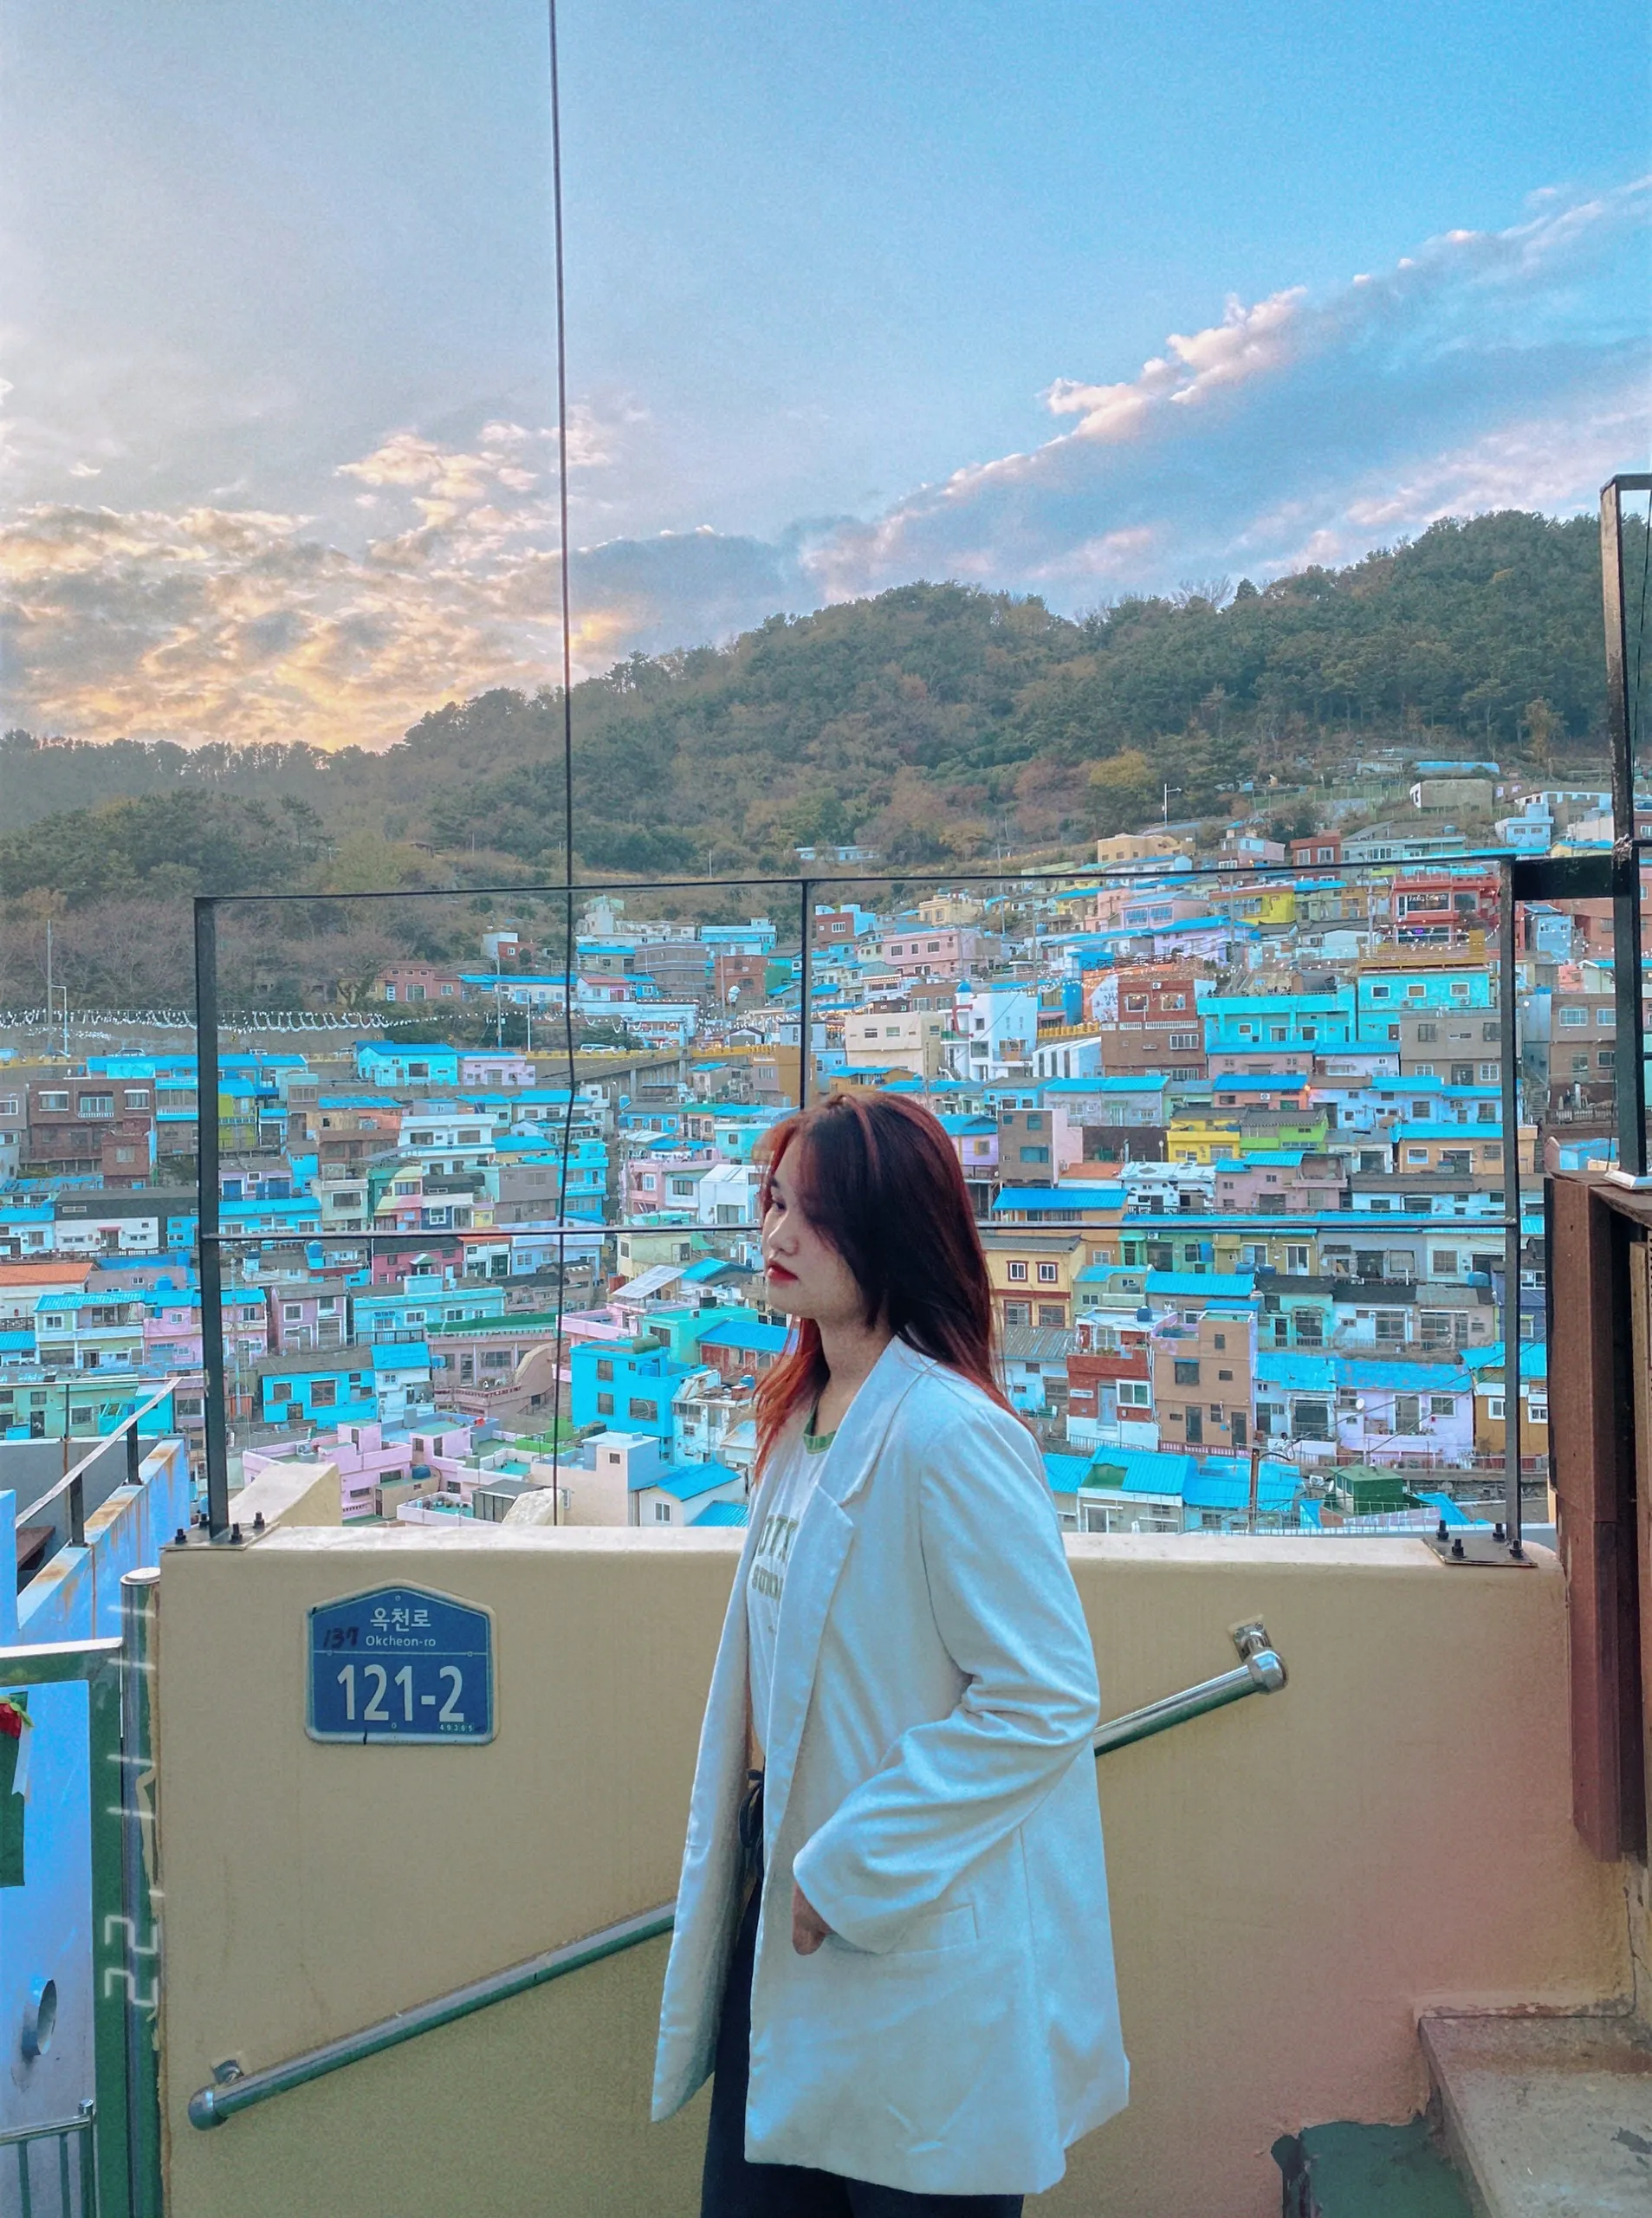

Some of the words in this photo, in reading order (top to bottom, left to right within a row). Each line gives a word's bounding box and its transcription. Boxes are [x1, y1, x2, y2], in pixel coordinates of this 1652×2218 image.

[370, 1607, 431, 1631] 옥천로
[323, 1627, 359, 1649] 137
[366, 1635, 437, 1647] Okcheon-ro
[336, 1664, 464, 1722] 121-2
